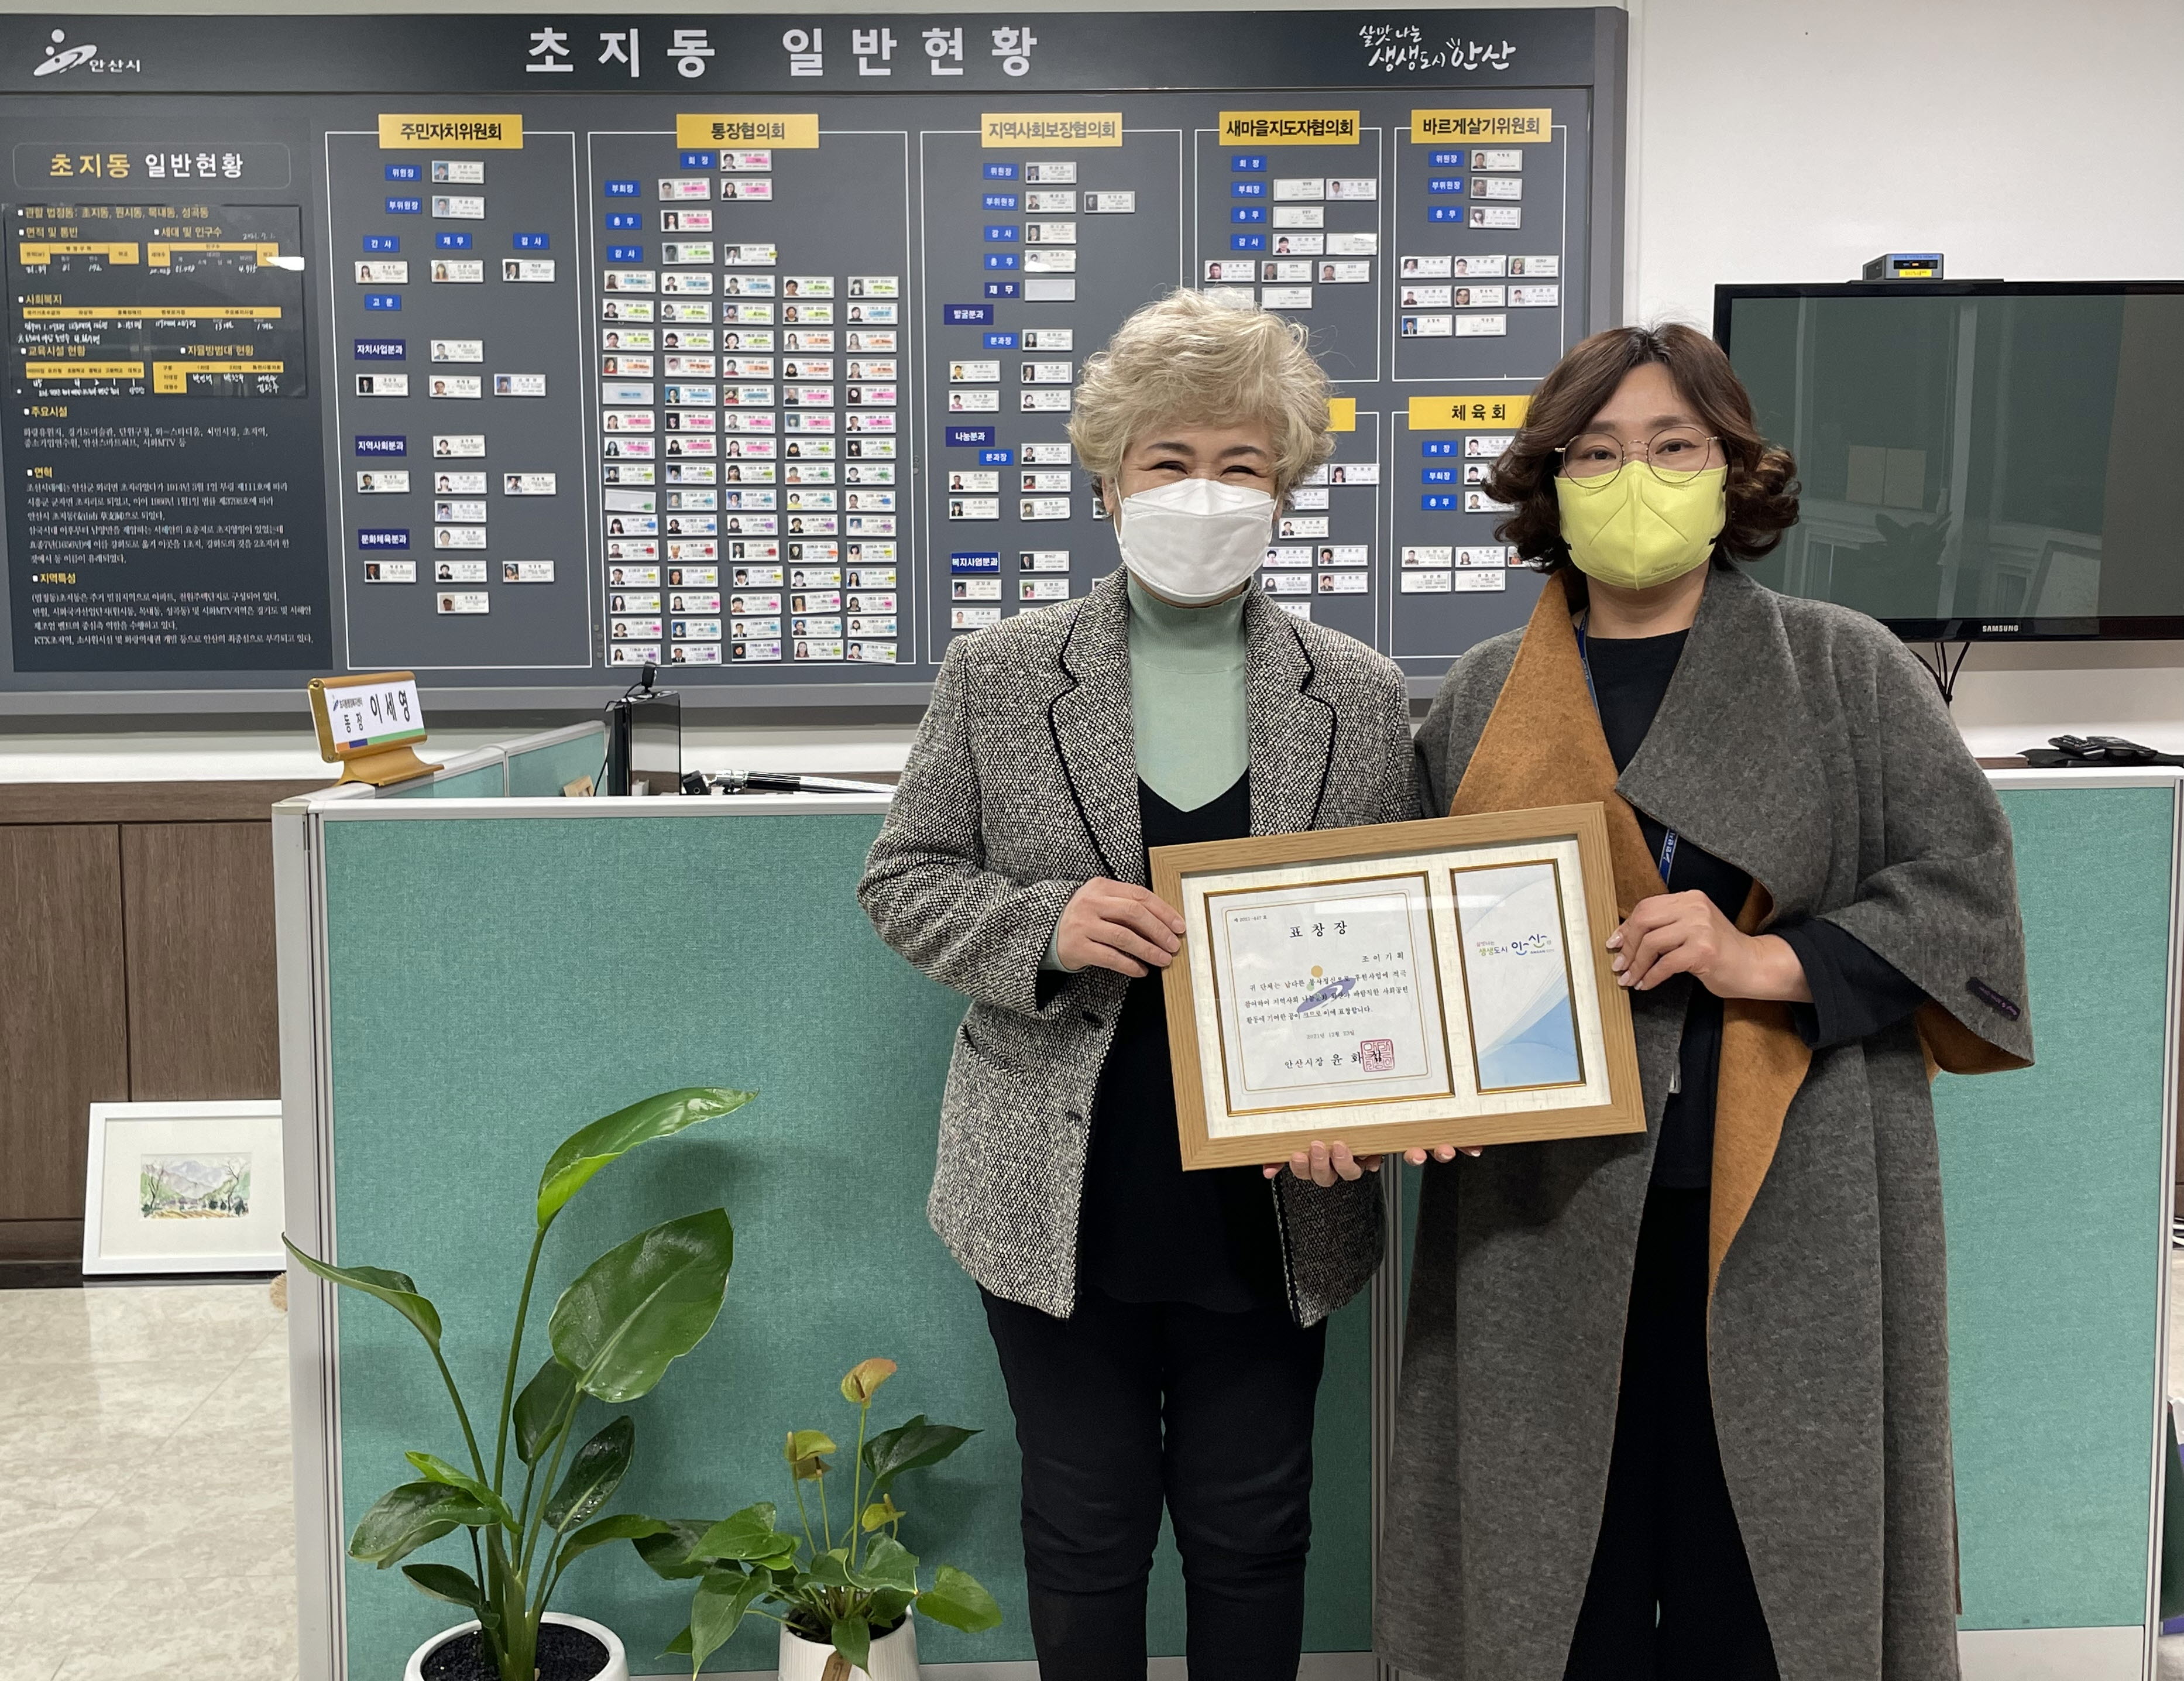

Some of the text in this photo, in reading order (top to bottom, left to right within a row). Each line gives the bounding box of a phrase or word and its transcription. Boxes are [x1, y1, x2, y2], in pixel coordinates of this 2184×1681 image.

[1359, 25, 1423, 47] 살맛 나는
[526, 26, 1038, 77] 초지동 일반현황
[1368, 39, 1516, 71] 생생도시 안산
[89, 59, 141, 73] 안산시
[710, 122, 785, 140] 통장협의회
[988, 121, 1115, 139] 지역사회보장협의회
[1226, 119, 1353, 136] 새마을지도자협의회
[1423, 117, 1540, 135] 바르게살기위원회
[401, 123, 502, 140] 주민자치위원회
[688, 155, 709, 165] 회장
[1239, 159, 1259, 168] 회장
[1436, 155, 1458, 163] 위원장
[49, 153, 245, 179] 초지동 일반현황
[393, 169, 414, 178] 위원장
[990, 167, 1012, 176] 위원장
[612, 184, 634, 194] 부회장
[1238, 185, 1260, 194] 부회장
[1431, 181, 1461, 190] 부위원장
[389, 201, 418, 210] 부위원장
[986, 197, 1015, 207] 부위원장
[195, 226, 222, 238] 인구수
[991, 229, 1012, 238] 감사
[1238, 238, 1259, 246] 감사
[614, 249, 635, 259] 감사
[989, 285, 1014, 294] 재무
[990, 337, 1012, 345] 분과장
[356, 344, 403, 355] 자치사업분과
[32, 406, 68, 417] 주요시설
[1451, 404, 1506, 421] 체육회
[955, 432, 985, 441] 나눔분과
[358, 441, 404, 451] 지역사회분과
[1430, 444, 1451, 454] 회장
[986, 453, 1007, 462] 분과장
[1428, 471, 1450, 481] 부회장
[1429, 498, 1450, 507] 총무
[360, 534, 407, 545] 문화체육분과
[952, 557, 998, 567] 복지사업분과
[370, 689, 411, 725] 이세영
[1289, 920, 1348, 938] 표창장
[1479, 934, 1547, 956] 생생도시 안산
[1285, 1057, 1324, 1069] 안산시장
